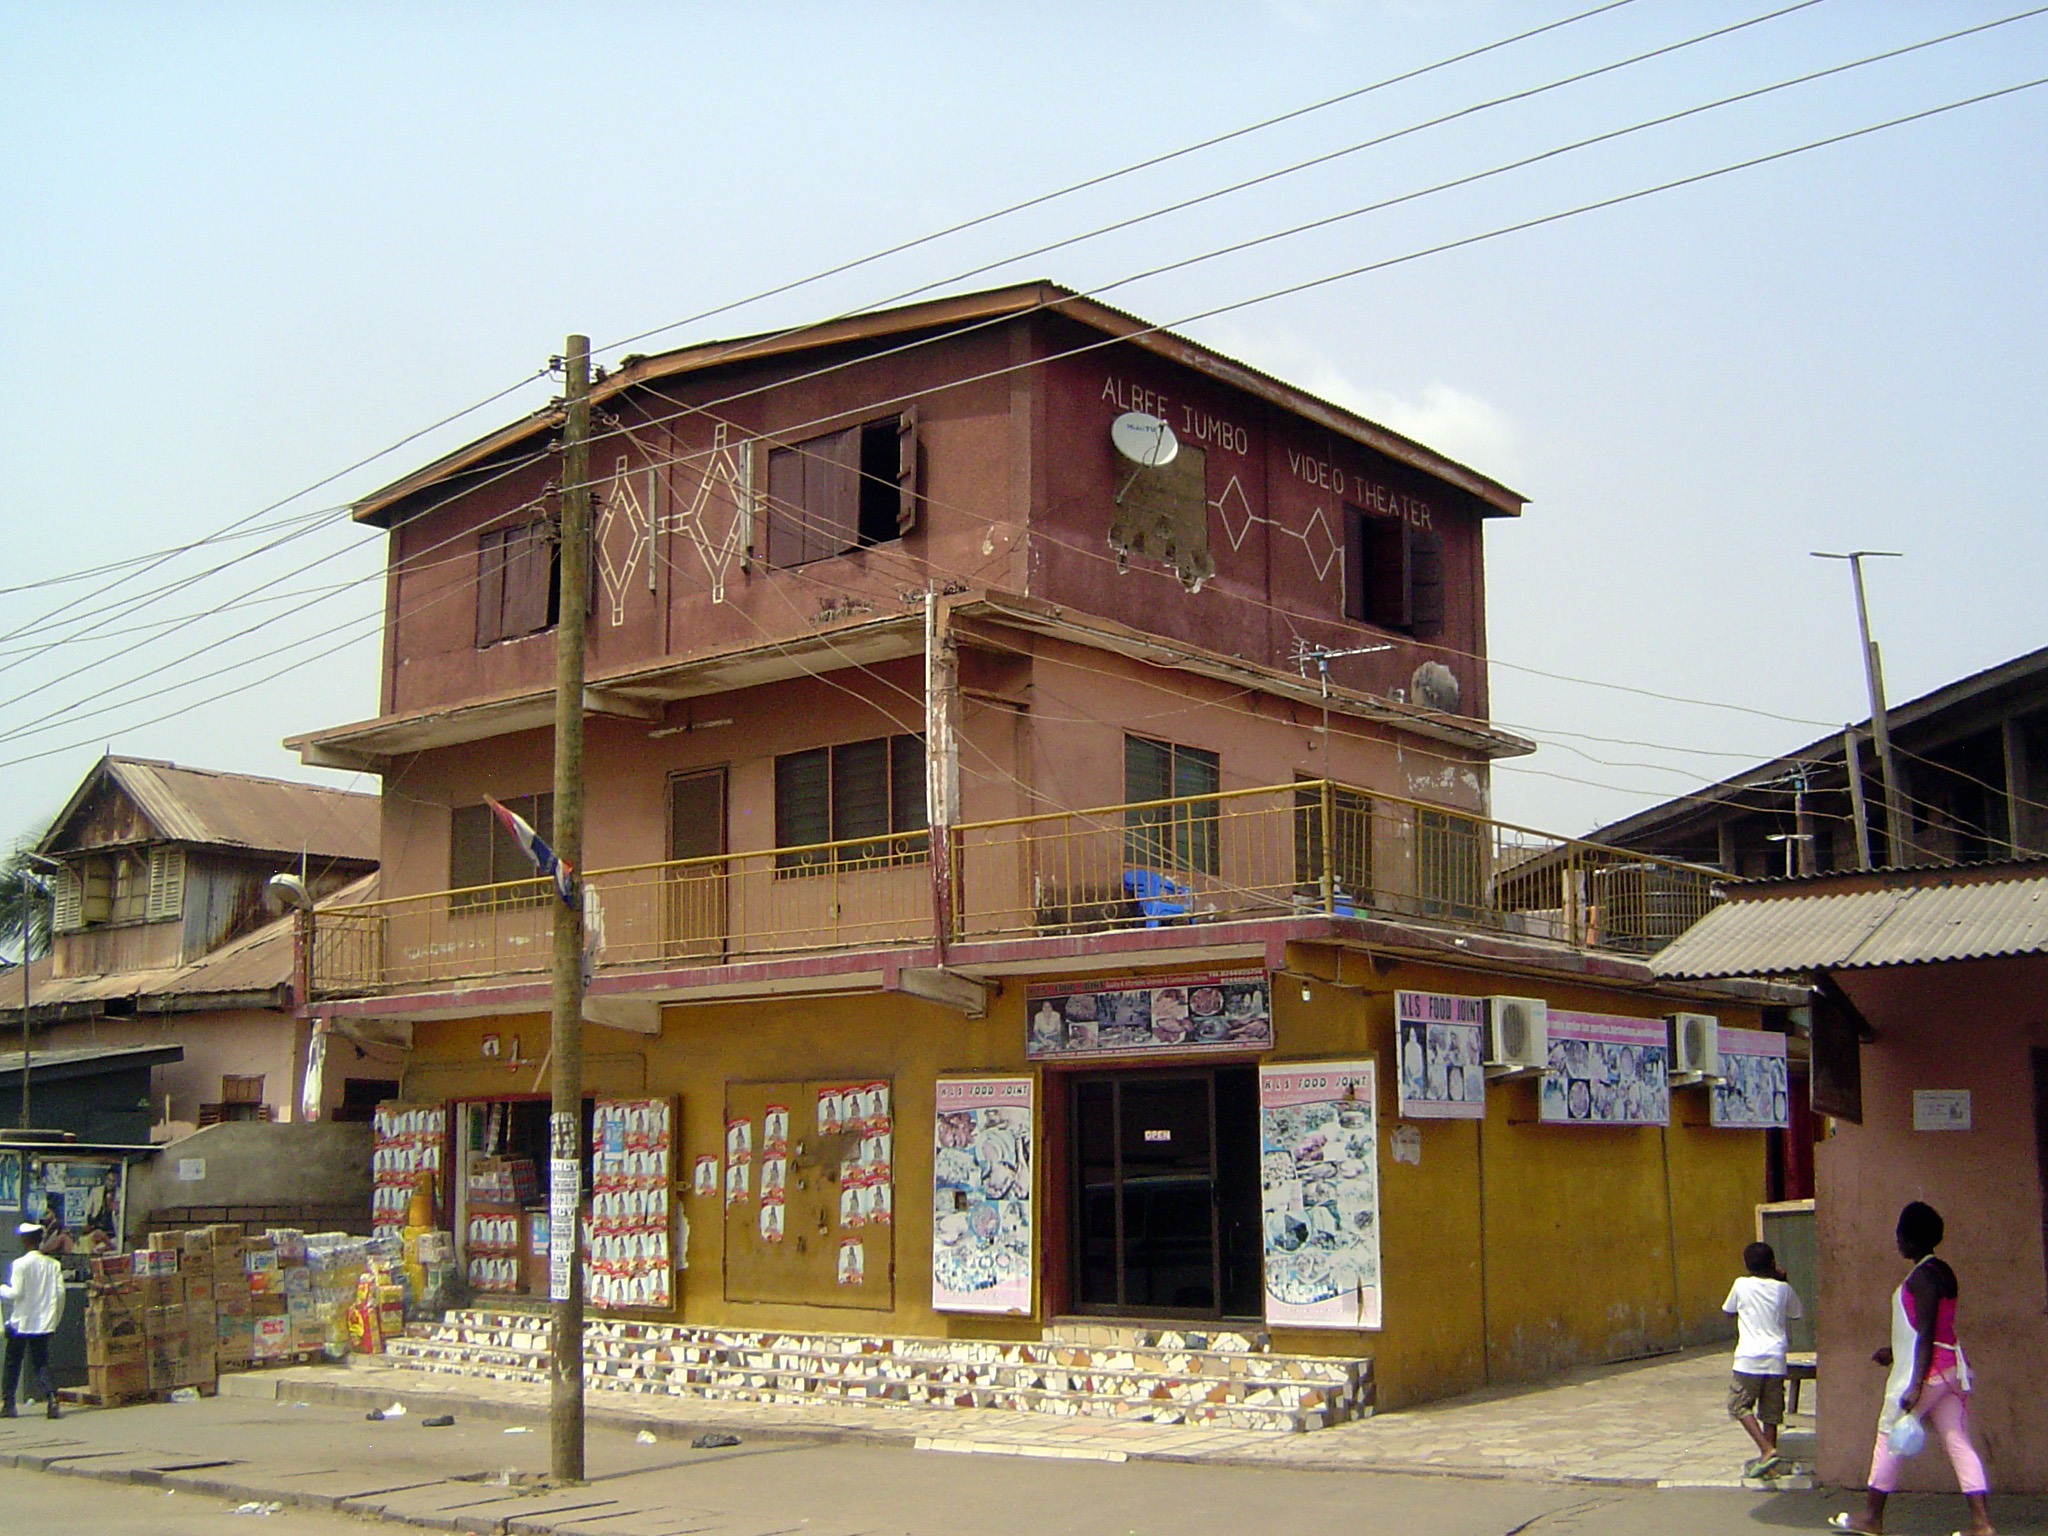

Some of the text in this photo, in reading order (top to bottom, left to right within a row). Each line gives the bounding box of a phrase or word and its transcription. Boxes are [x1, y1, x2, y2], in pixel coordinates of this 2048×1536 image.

[1101, 376, 1248, 455] ALBEE JUMBO
[1287, 447, 1433, 532] VIDEO THEATER
[1399, 992, 1481, 1022] KLS FOOD JOINT
[969, 1085, 995, 1096] FOOD
[1001, 1084, 1029, 1095] JOINT
[1297, 1077, 1328, 1089] FOOD
